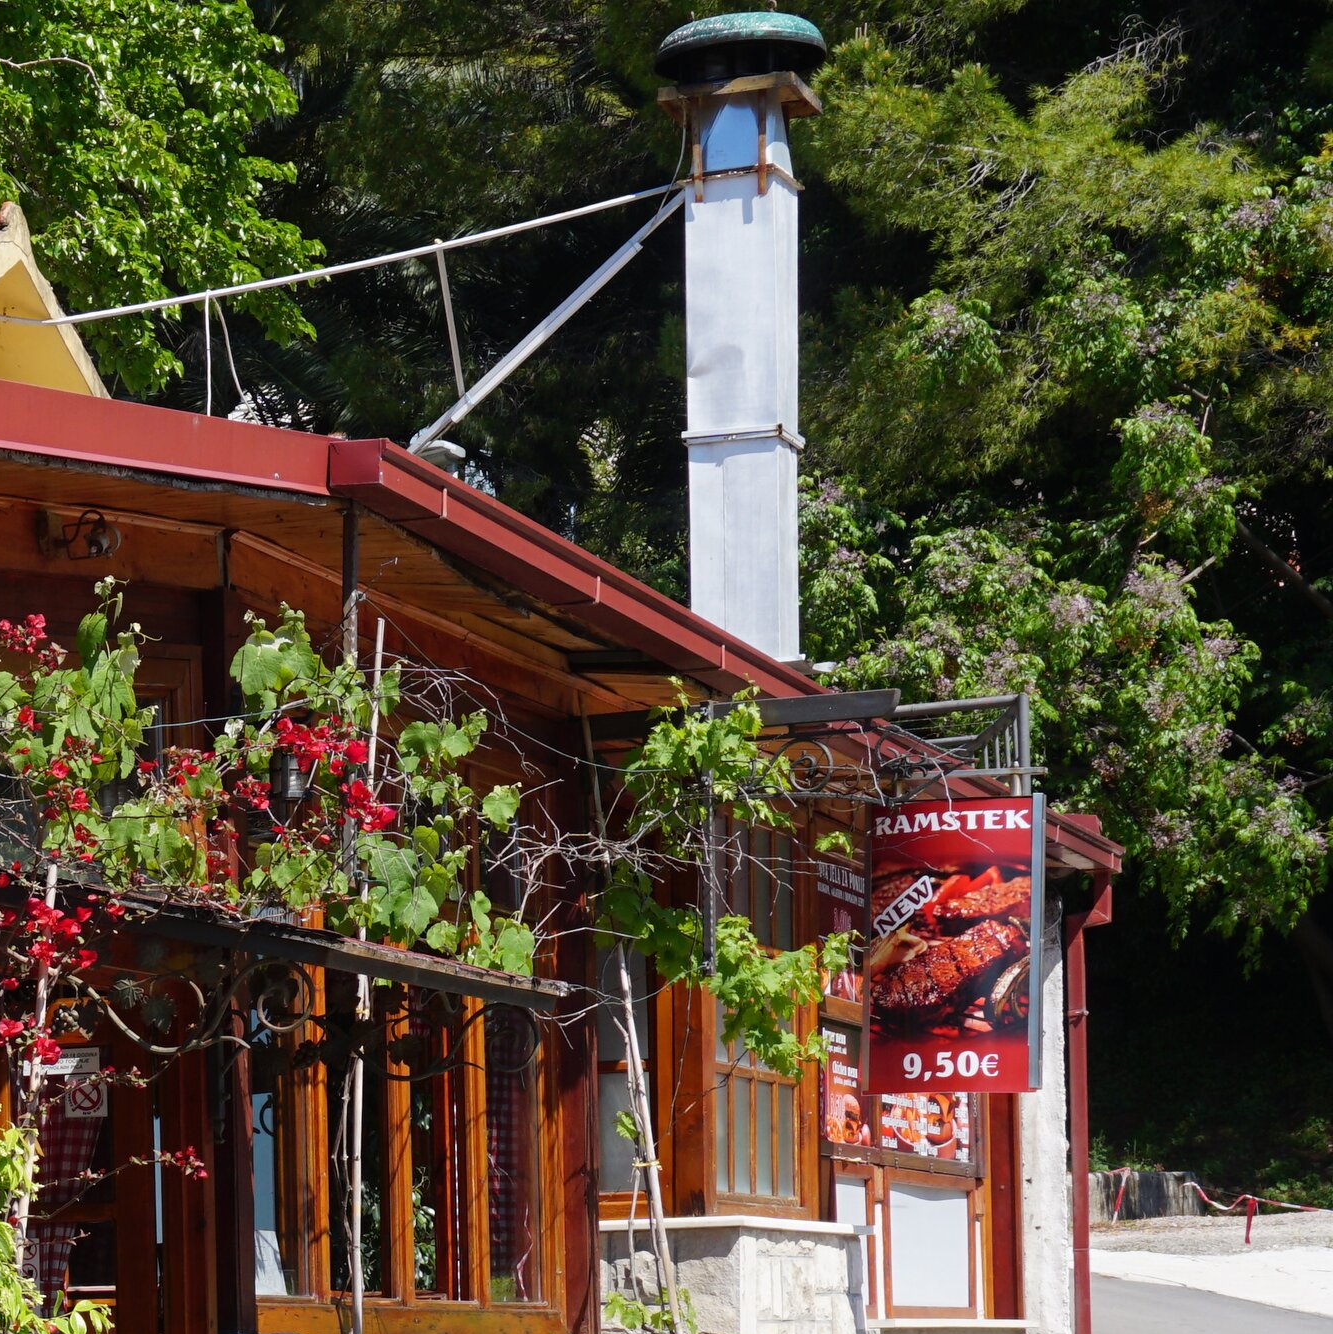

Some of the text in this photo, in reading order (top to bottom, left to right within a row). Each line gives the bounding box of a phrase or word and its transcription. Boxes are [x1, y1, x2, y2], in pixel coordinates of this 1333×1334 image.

[875, 808, 1032, 837] RAMSTEK
[875, 877, 933, 936] NEW
[902, 1050, 999, 1082] 9,50€
